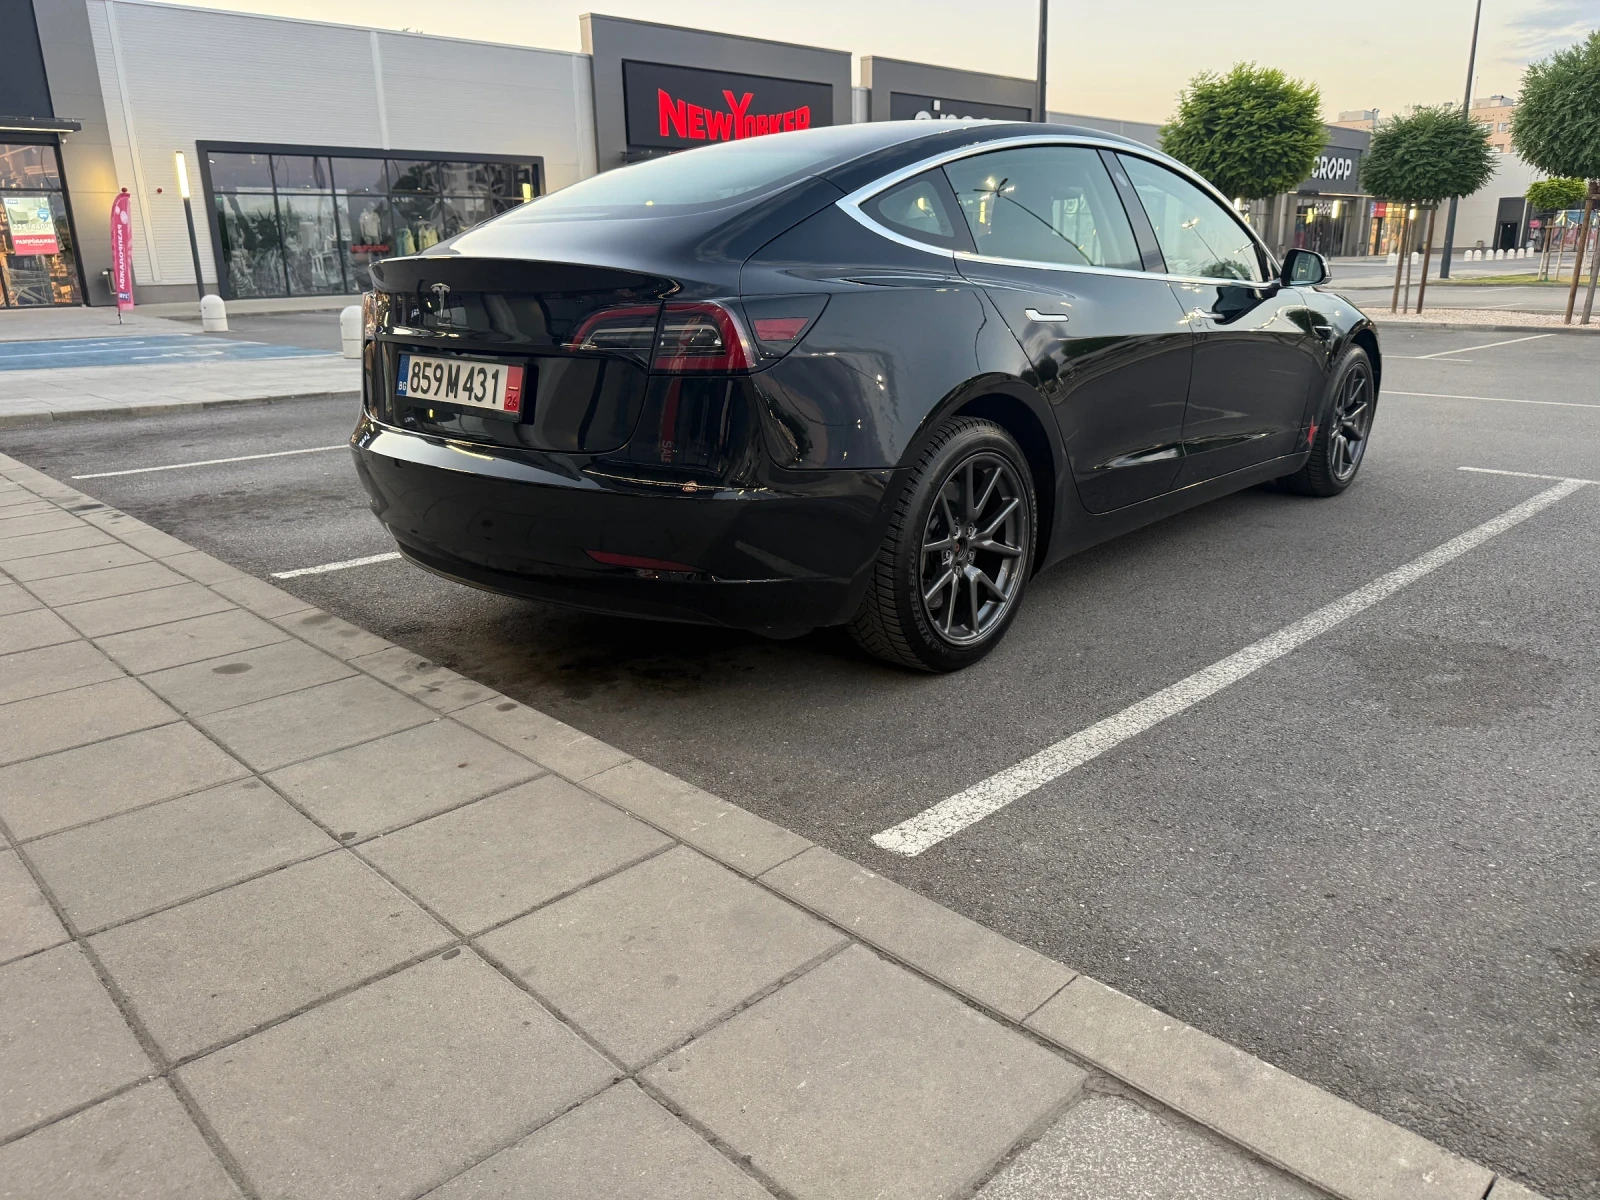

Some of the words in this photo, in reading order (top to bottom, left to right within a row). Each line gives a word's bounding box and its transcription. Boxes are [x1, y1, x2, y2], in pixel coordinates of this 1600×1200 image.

[1311, 156, 1352, 180] CROPP
[398, 381, 407, 391] BG
[506, 395, 518, 407] 26
